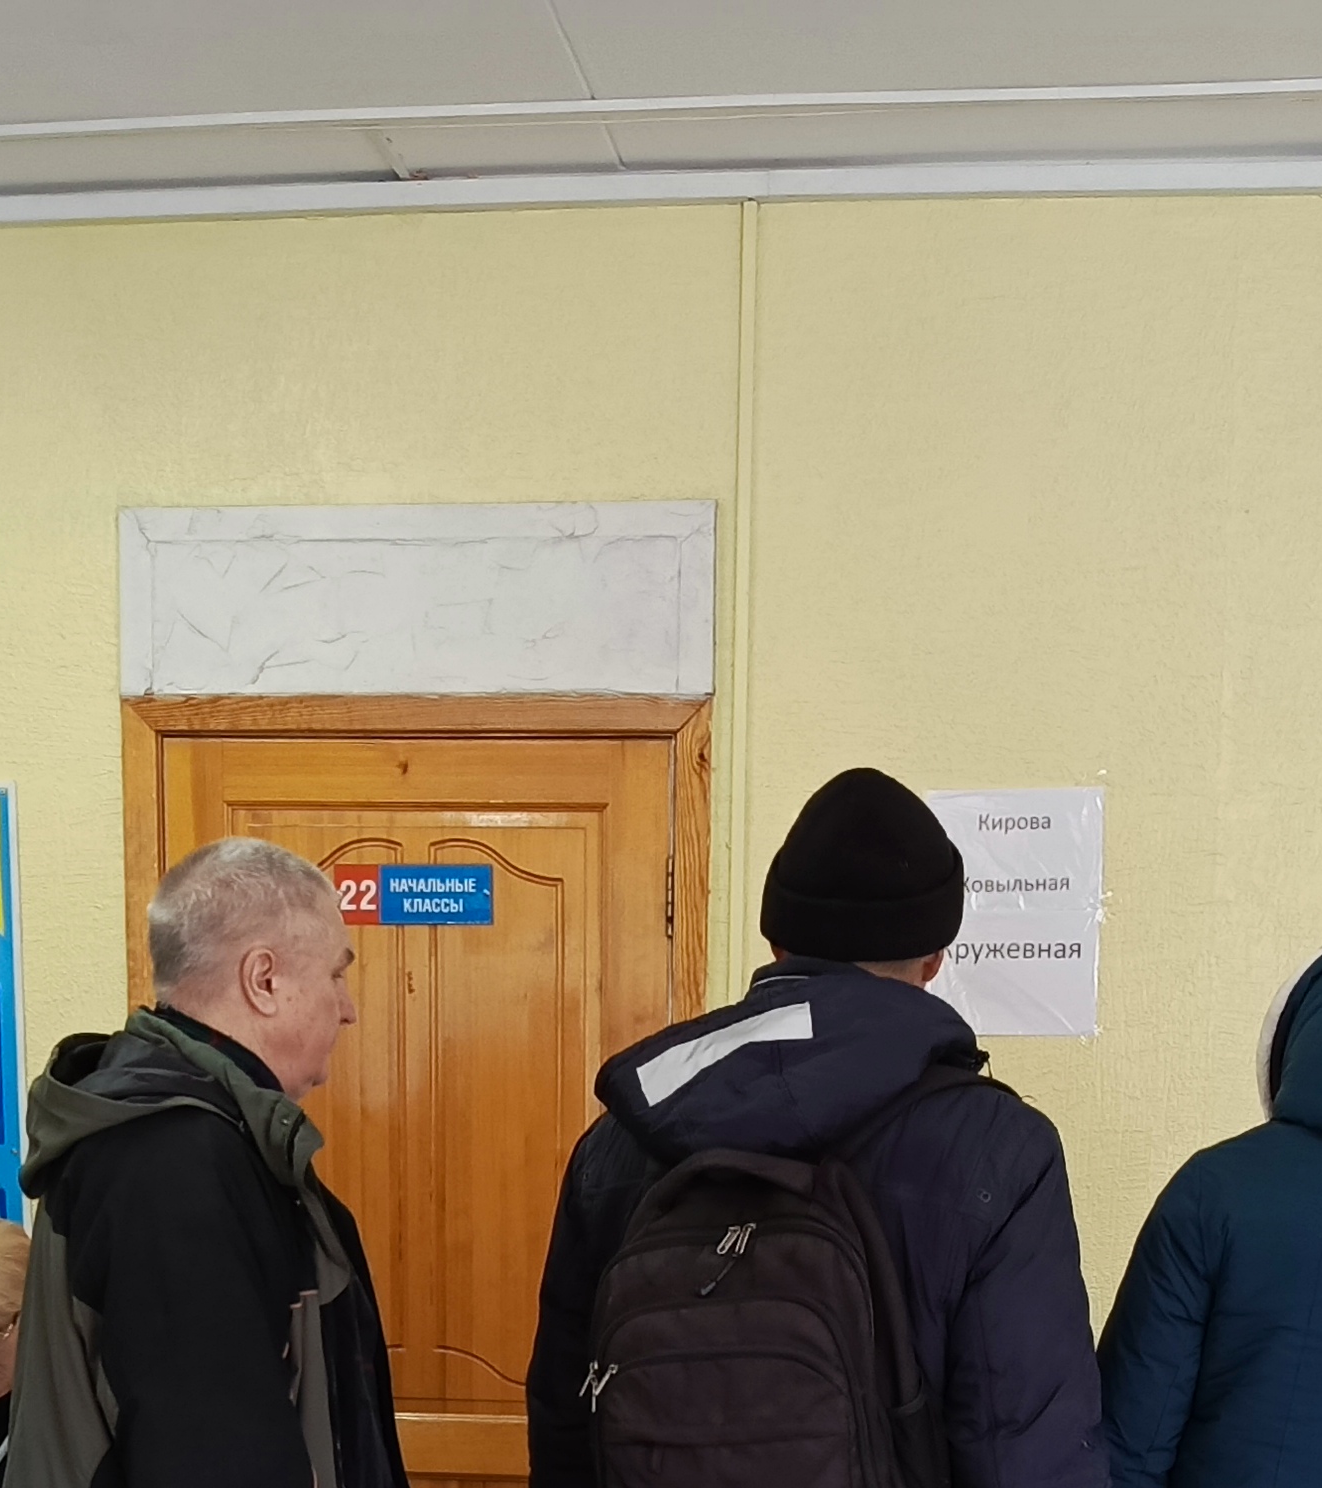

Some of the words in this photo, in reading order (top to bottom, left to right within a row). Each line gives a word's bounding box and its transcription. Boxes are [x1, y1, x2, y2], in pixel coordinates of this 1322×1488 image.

[978, 813, 1051, 834] Кирова
[389, 878, 476, 893] НАЧАЛЬНЫЕ
[341, 879, 376, 911] 22
[403, 898, 463, 912] КЛАССЫ
